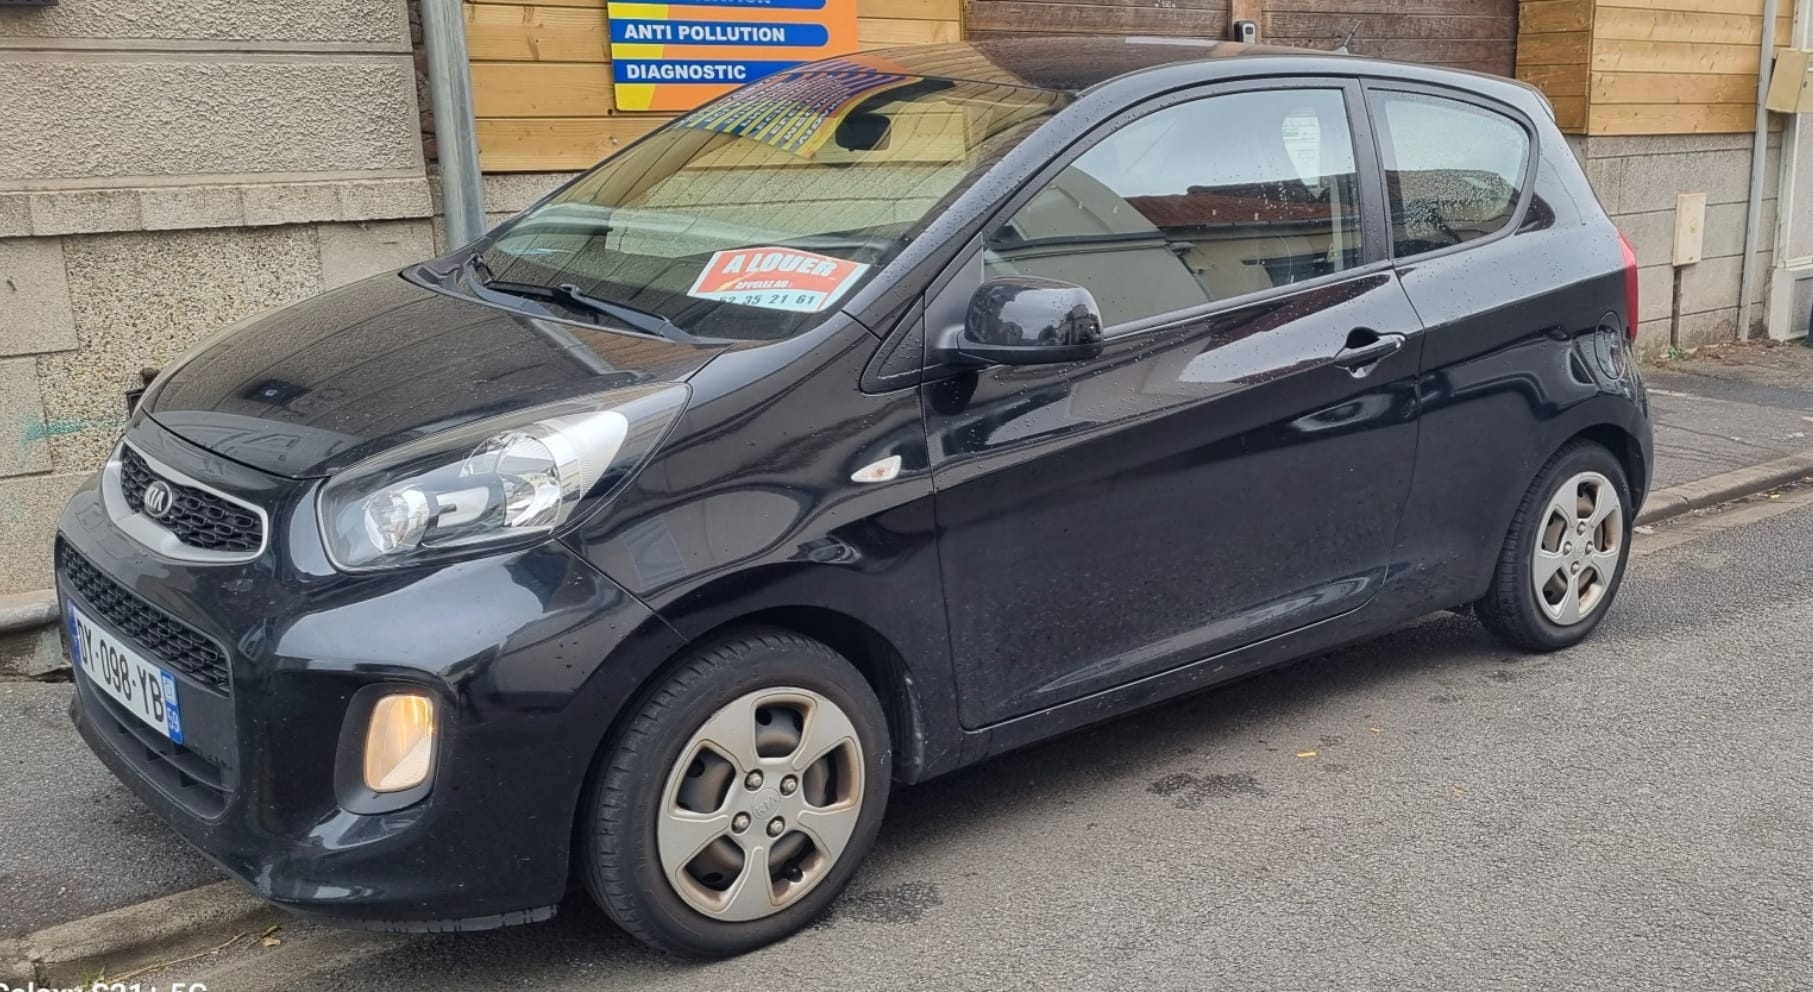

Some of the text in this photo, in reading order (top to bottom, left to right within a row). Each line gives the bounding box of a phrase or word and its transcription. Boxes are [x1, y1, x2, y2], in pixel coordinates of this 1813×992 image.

[624, 24, 786, 42] ANTI POLLUTION
[626, 63, 747, 80] DIAGNOSTIC
[722, 252, 838, 277] A LOUER
[743, 295, 761, 305] 35
[768, 294, 789, 305] 21
[796, 294, 816, 305] 61
